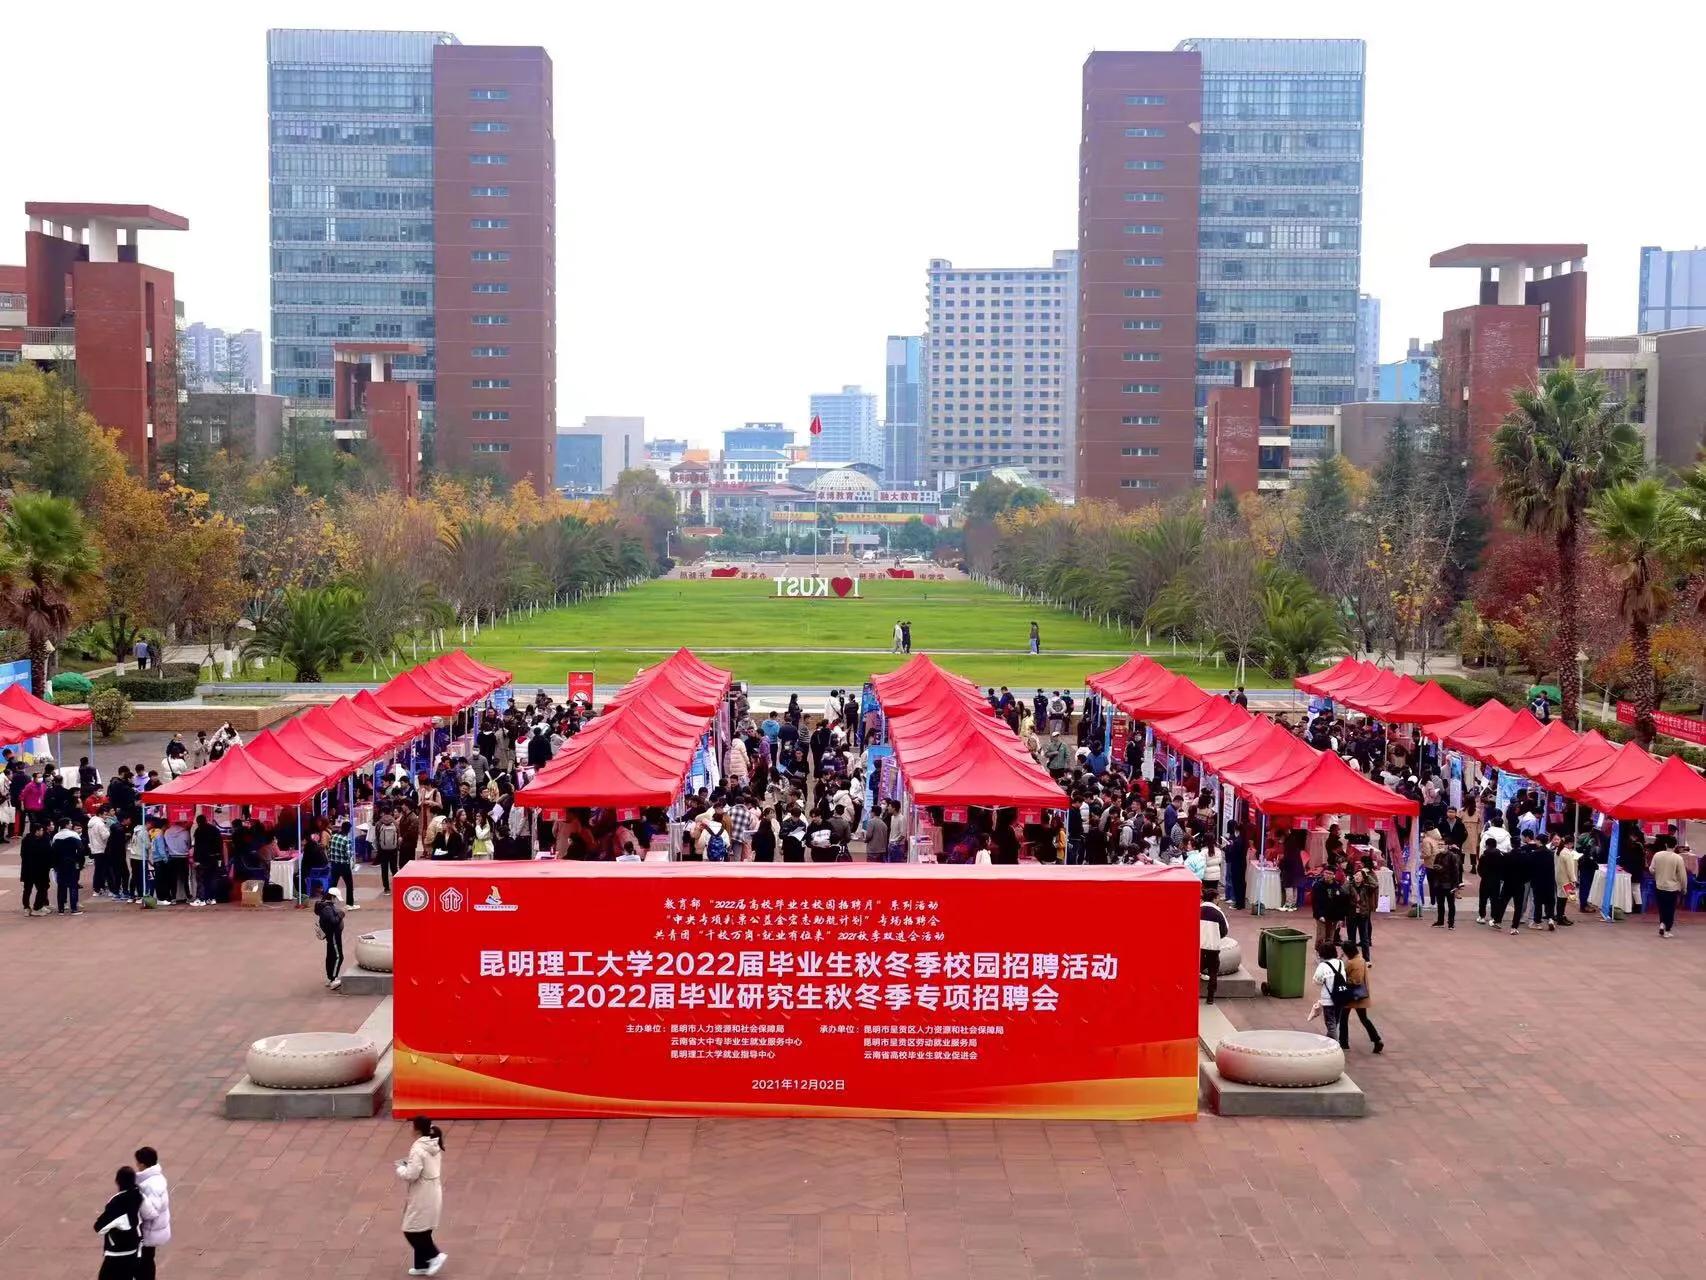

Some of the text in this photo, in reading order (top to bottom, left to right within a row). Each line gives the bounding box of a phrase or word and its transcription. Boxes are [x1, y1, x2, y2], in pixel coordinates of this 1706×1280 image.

[664, 897, 701, 911] 教育部
[891, 899, 939, 911] 系列活动
[878, 913, 940, 927] 专场招聘会
[655, 928, 690, 941] 共青团
[479, 949, 1118, 980] 昆明理工大学2022届毕业生秋冬季校园招聘活动
[537, 982, 1059, 1012] 暨2022届毕业研究生秋冬季专项招聘会
[670, 1024, 785, 1034] 昆明市人力资源和社会保障局
[863, 1024, 1004, 1035] 昆明市呈贡区人力资源和社会保障局
[671, 1037, 803, 1047] 云南省大中专毕业生就业服务中心
[863, 1037, 978, 1048] 昆明市呈贡区劳动就业服务局
[670, 1049, 776, 1059] 昆明理工大学就业指导中心
[864, 1050, 978, 1060] 云南省高校毕业生就业促进会
[751, 1079, 845, 1090] 2021年12月02日
